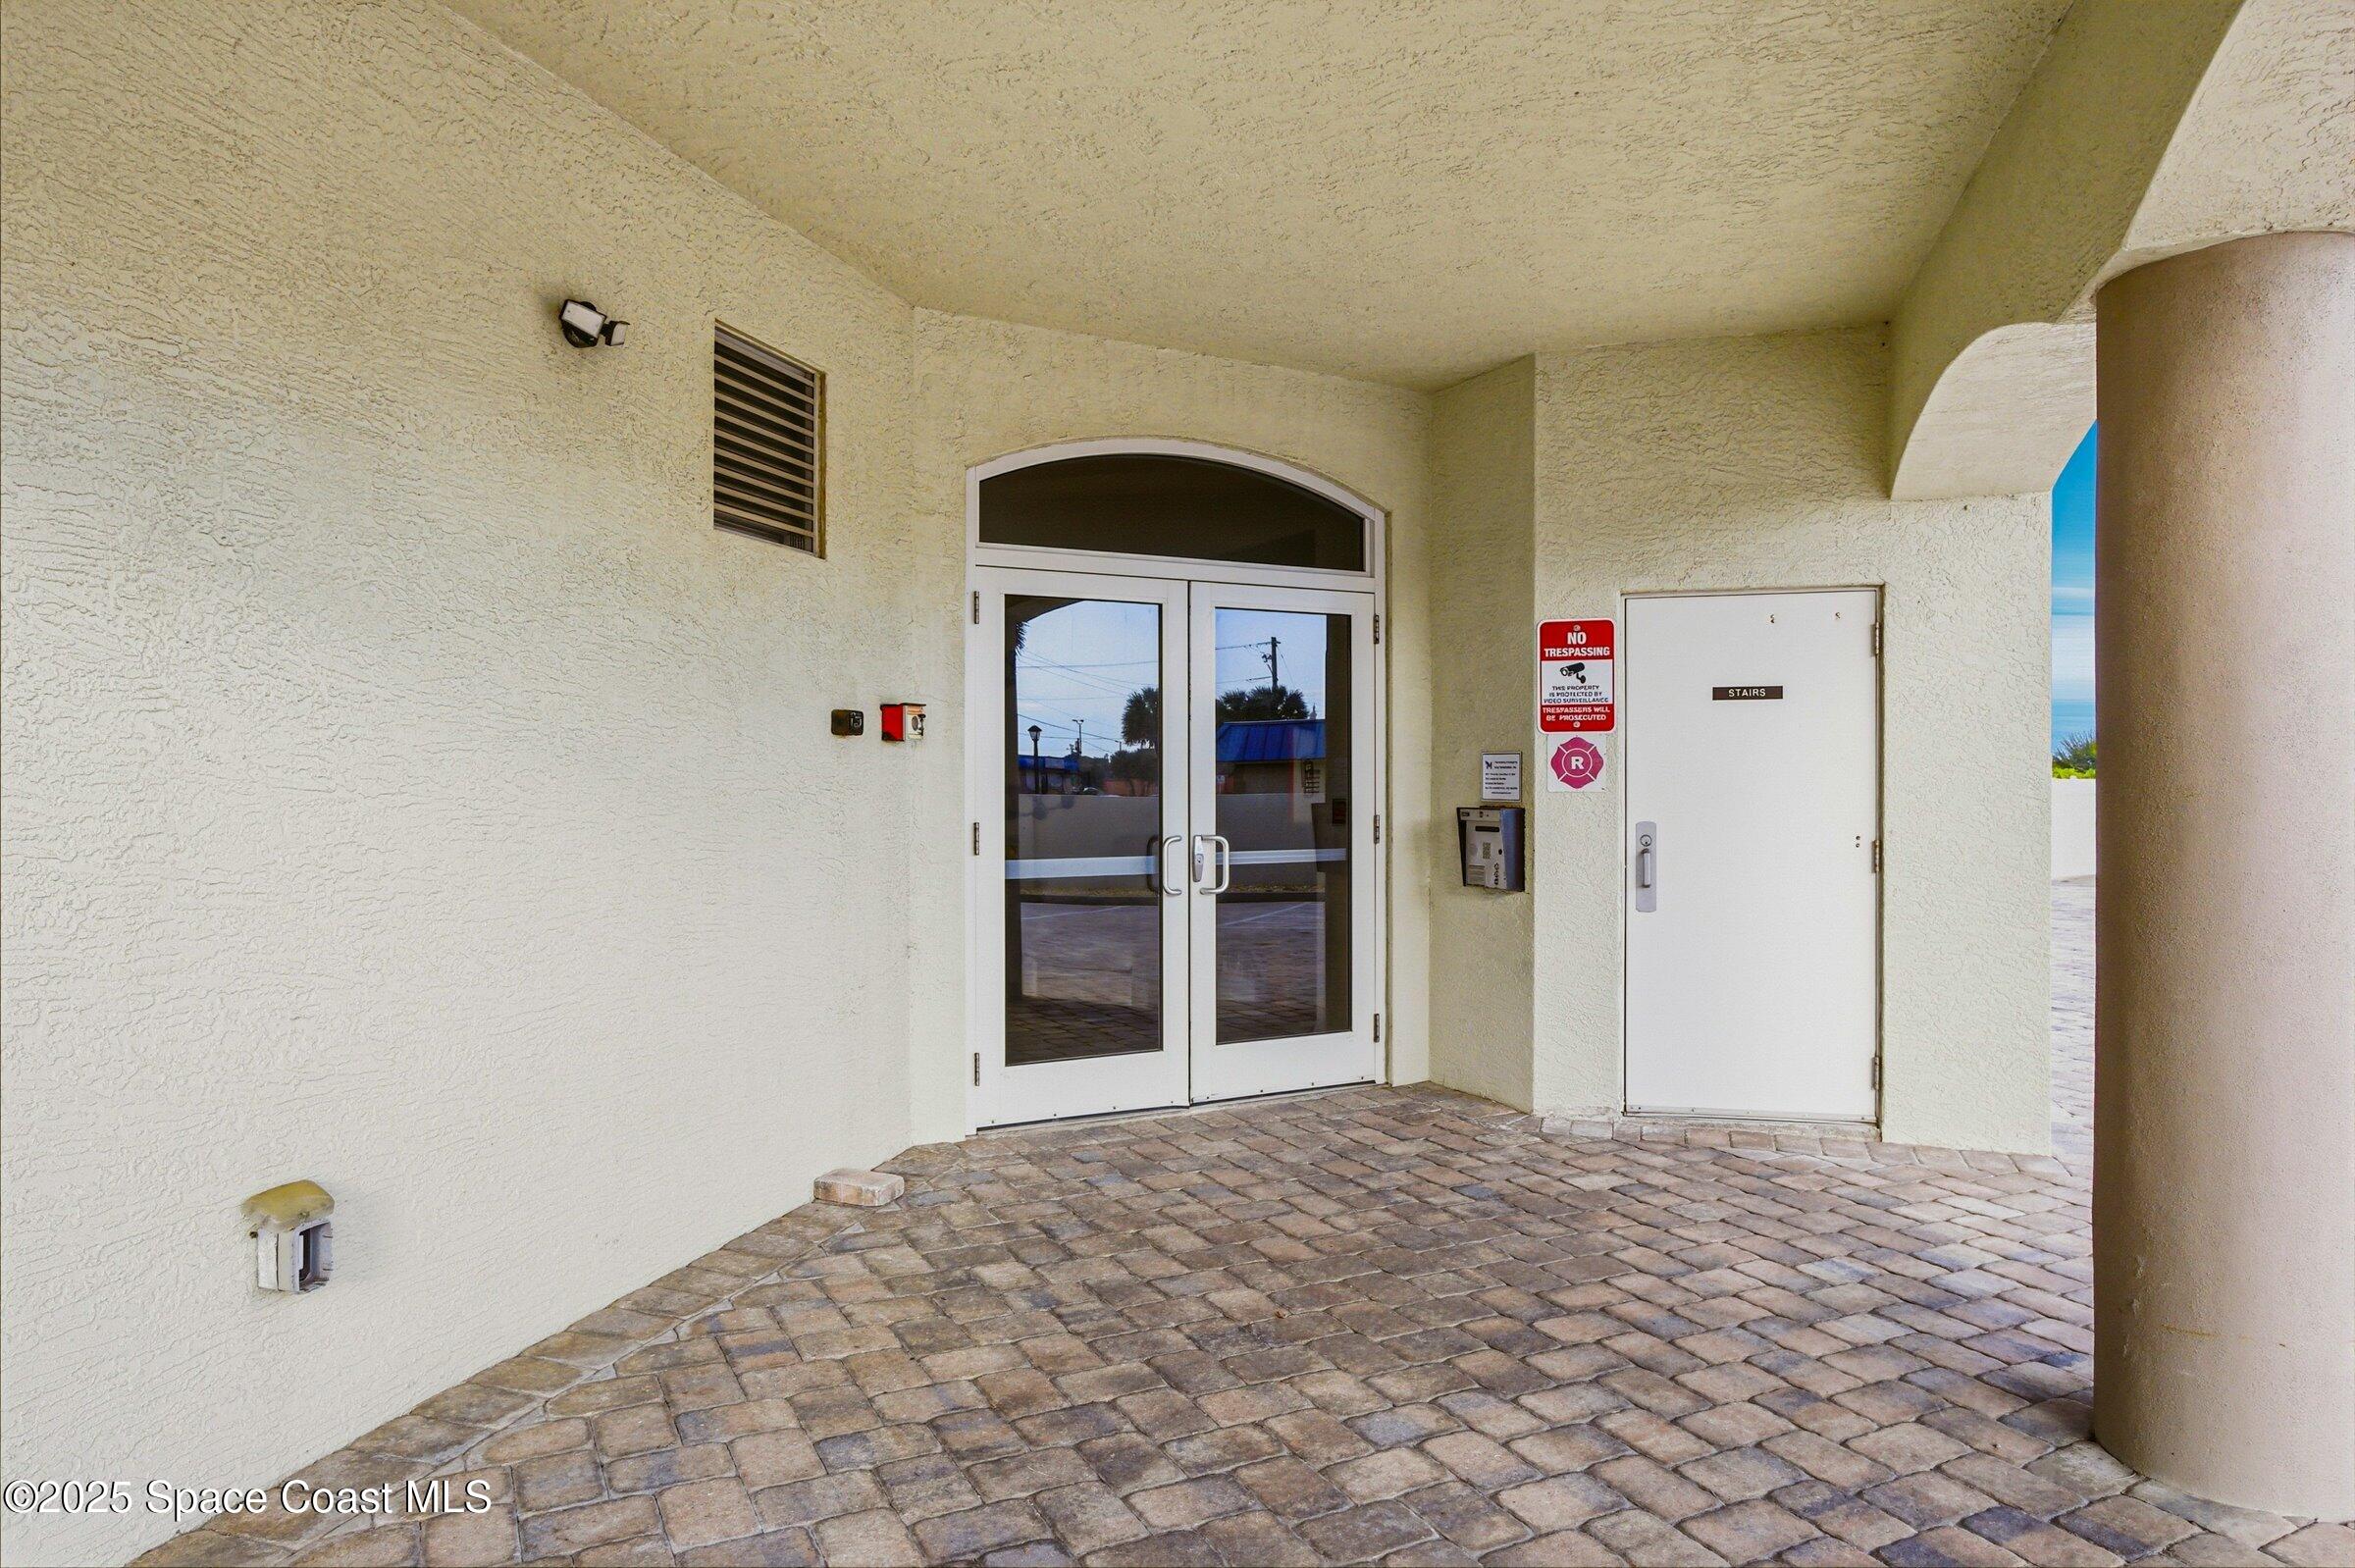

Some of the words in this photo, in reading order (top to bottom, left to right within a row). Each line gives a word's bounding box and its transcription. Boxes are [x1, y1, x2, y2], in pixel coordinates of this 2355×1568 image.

[1567, 631, 1587, 645] NO
[1544, 647, 1610, 657] TRESPASSING
[1728, 688, 1766, 698] STAIRS
[1571, 756, 1585, 770] R
